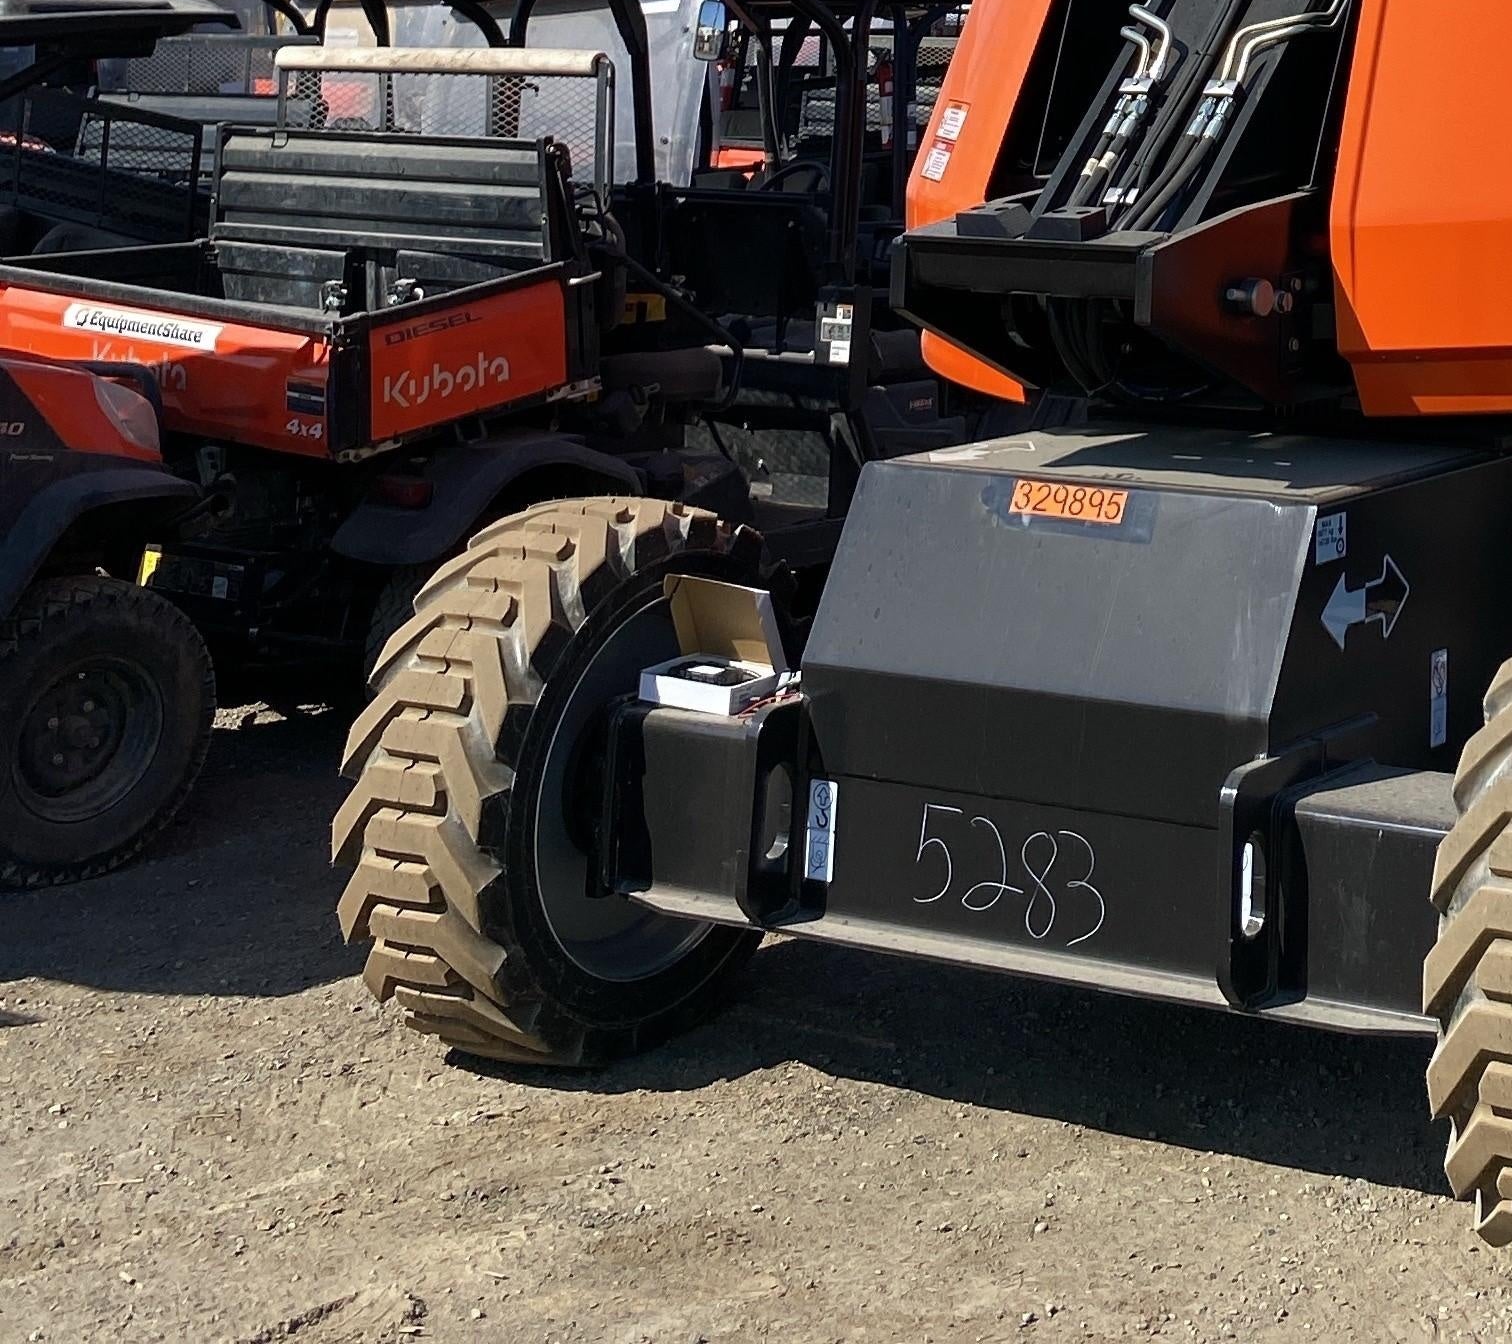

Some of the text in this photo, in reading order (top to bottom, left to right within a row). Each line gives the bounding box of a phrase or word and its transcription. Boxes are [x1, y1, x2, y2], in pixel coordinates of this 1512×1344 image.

[90, 311, 204, 343] EquipmentShare
[385, 312, 484, 346] DIESEL
[383, 352, 510, 408] Kubota
[286, 418, 323, 439] 4x4
[1014, 481, 1124, 520] 329895
[913, 803, 1105, 947] 5283
